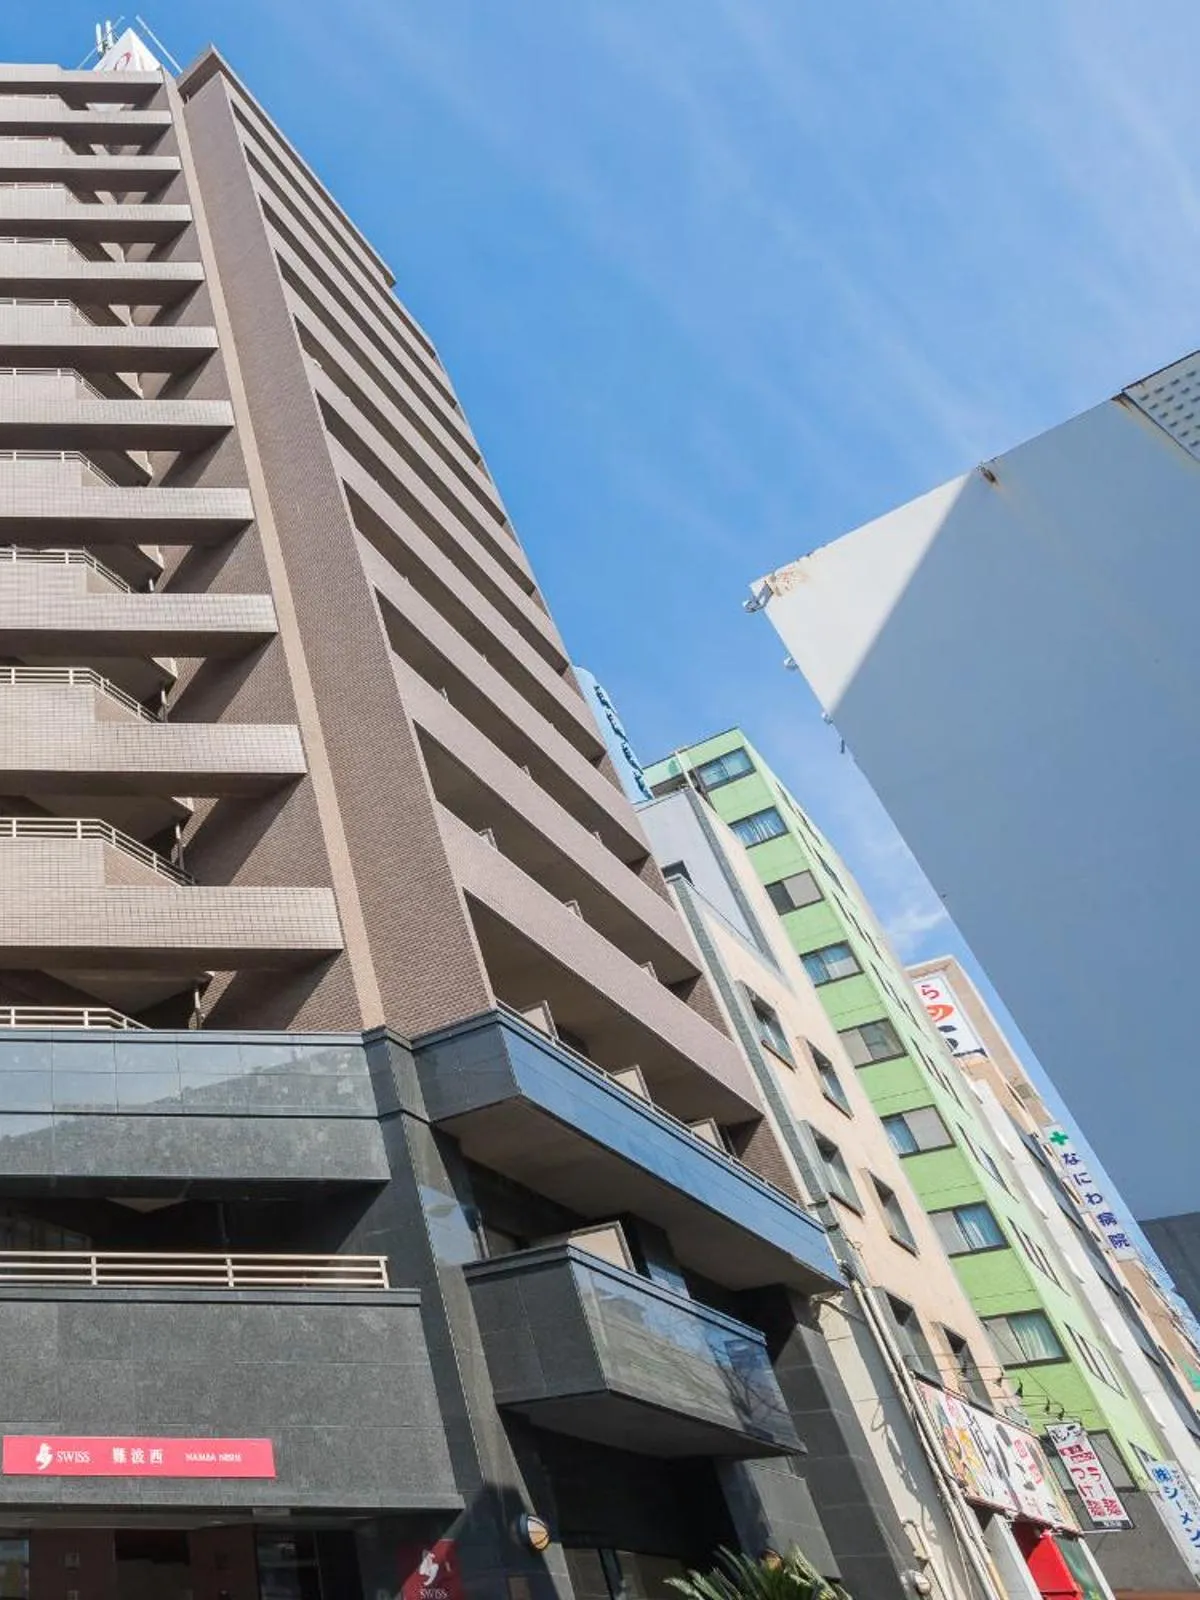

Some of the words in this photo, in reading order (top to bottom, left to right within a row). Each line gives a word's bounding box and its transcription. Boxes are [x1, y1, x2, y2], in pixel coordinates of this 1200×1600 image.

[1062, 1153, 1131, 1249] なにわ病院
[56, 1450, 92, 1464] SWISS
